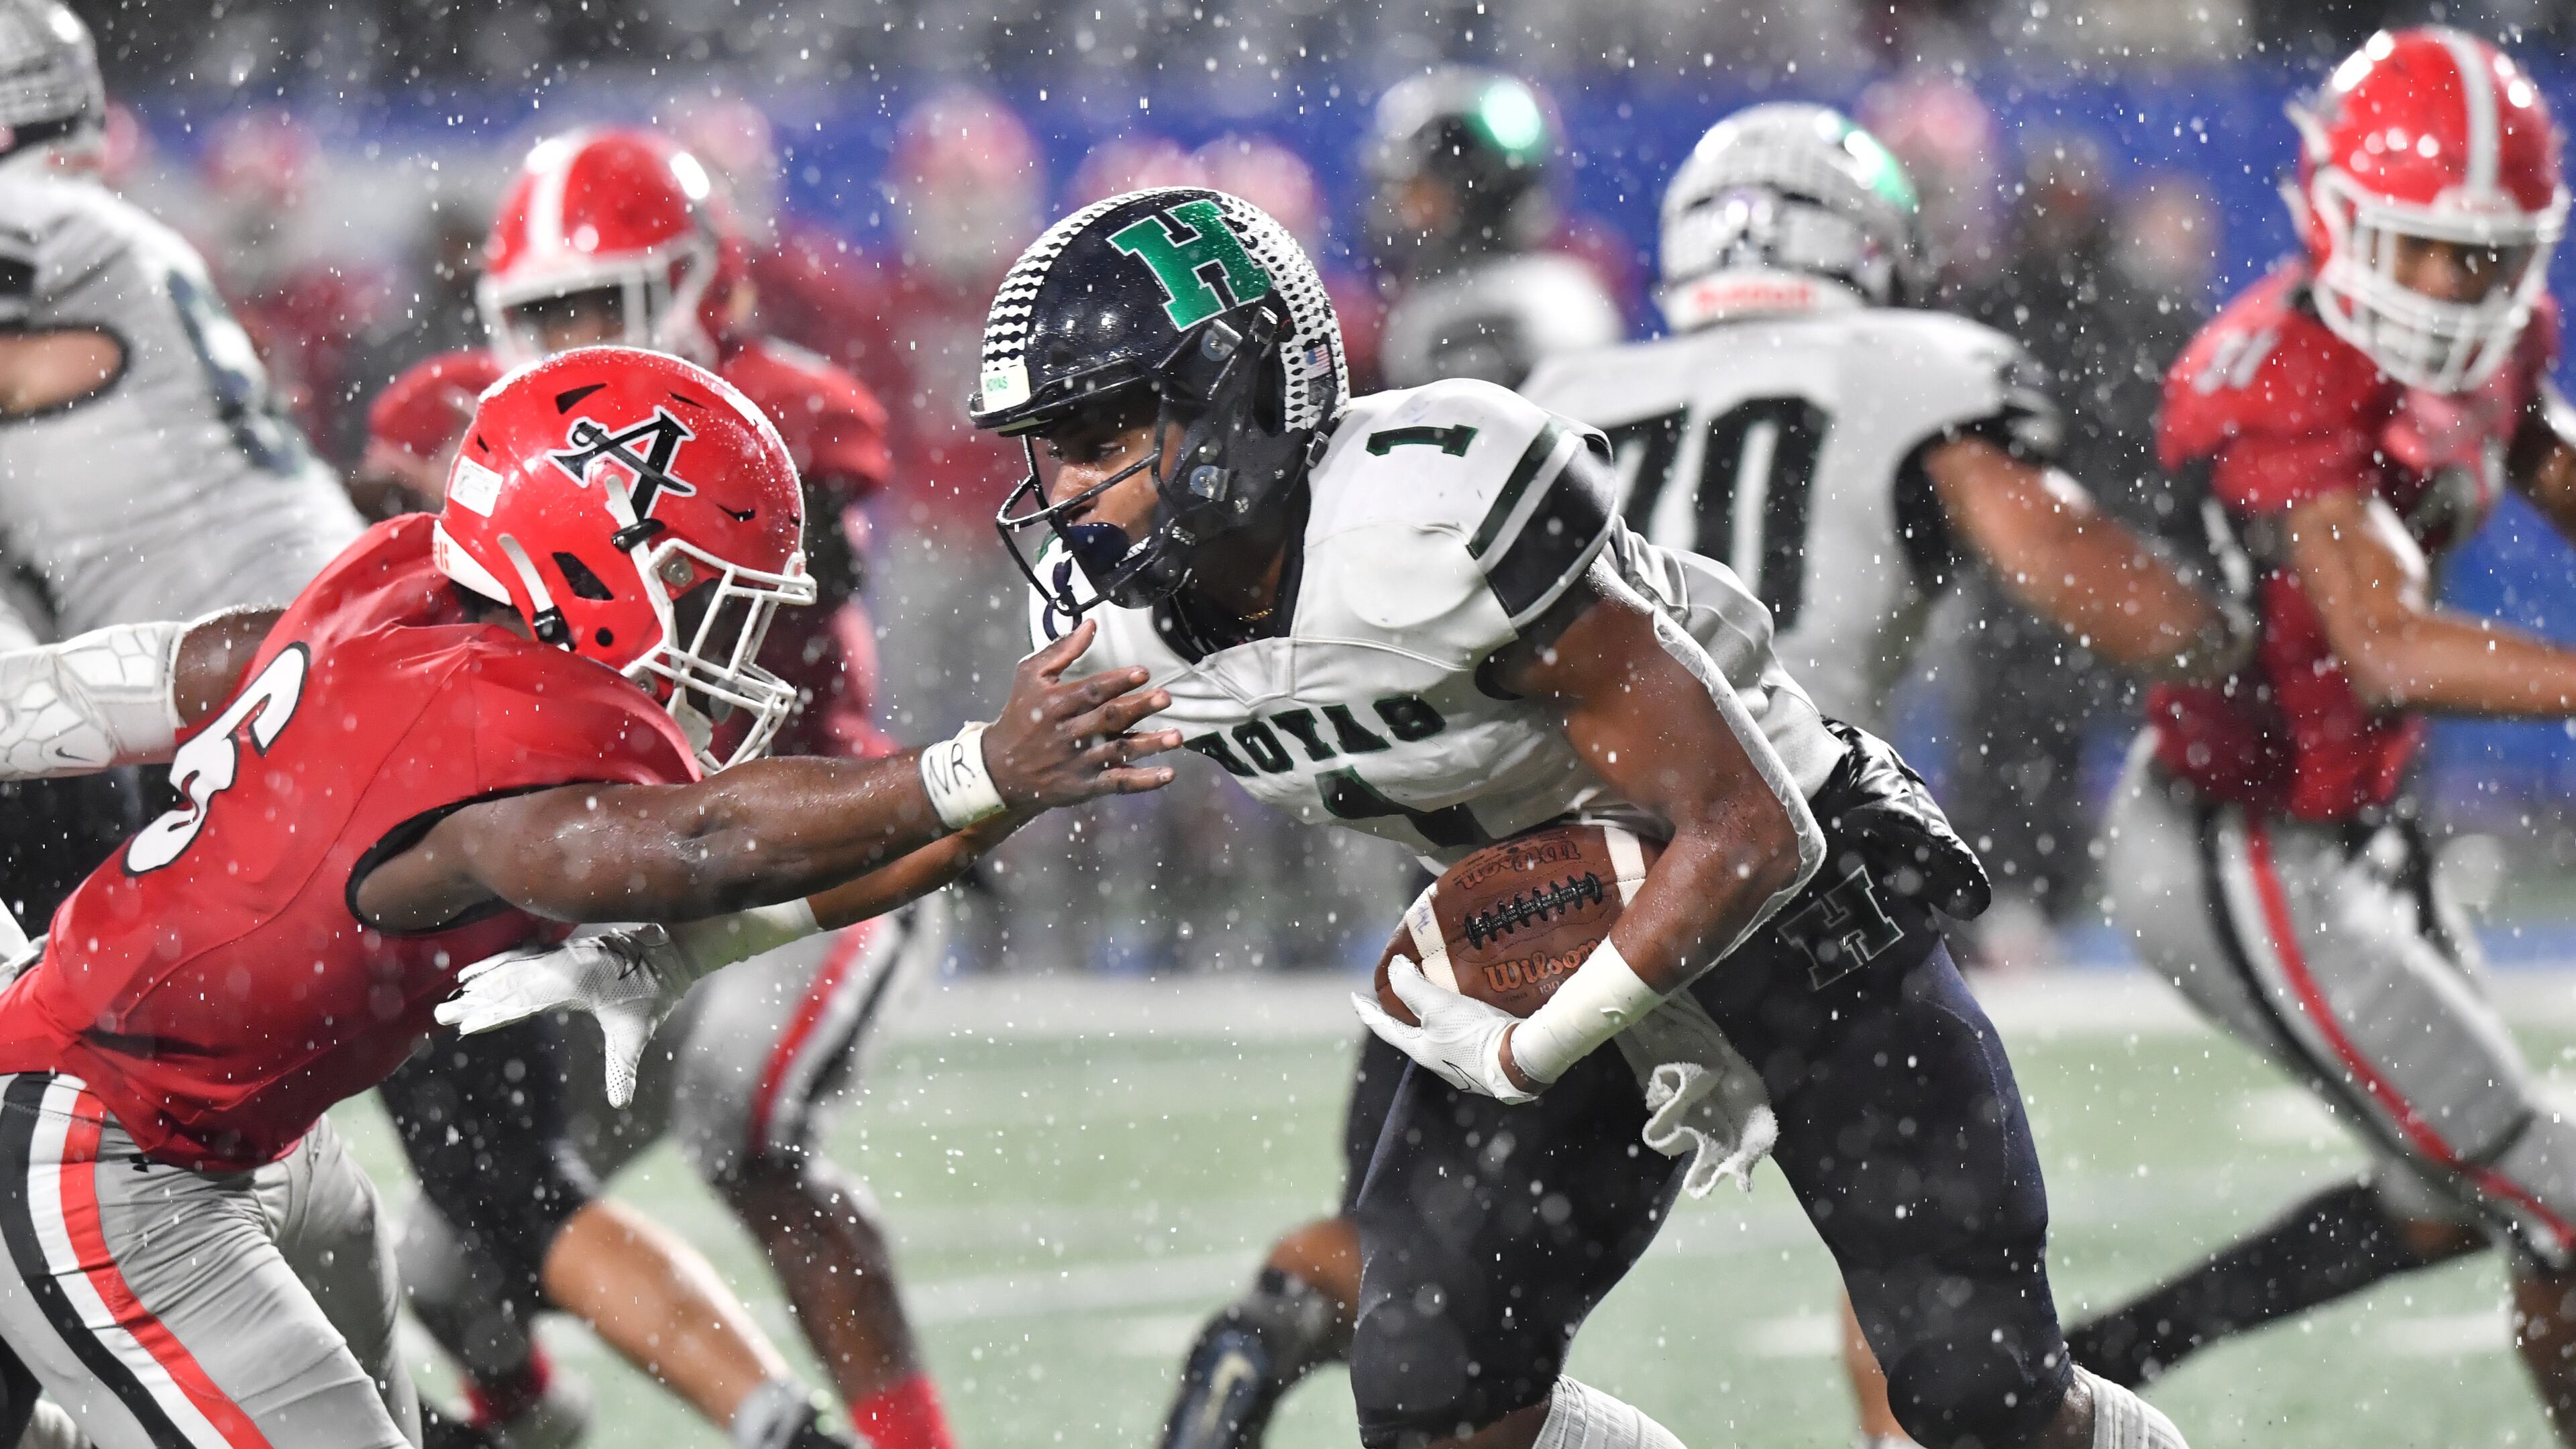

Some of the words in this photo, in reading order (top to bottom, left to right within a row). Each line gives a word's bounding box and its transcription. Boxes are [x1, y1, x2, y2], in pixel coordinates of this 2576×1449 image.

[1106, 199, 1275, 332] H
[547, 405, 697, 522] A
[1366, 424, 1479, 457] 1
[1454, 840, 1581, 890] Wilson
[1482, 937, 1602, 993] Wilson
[1776, 864, 1904, 991] H
